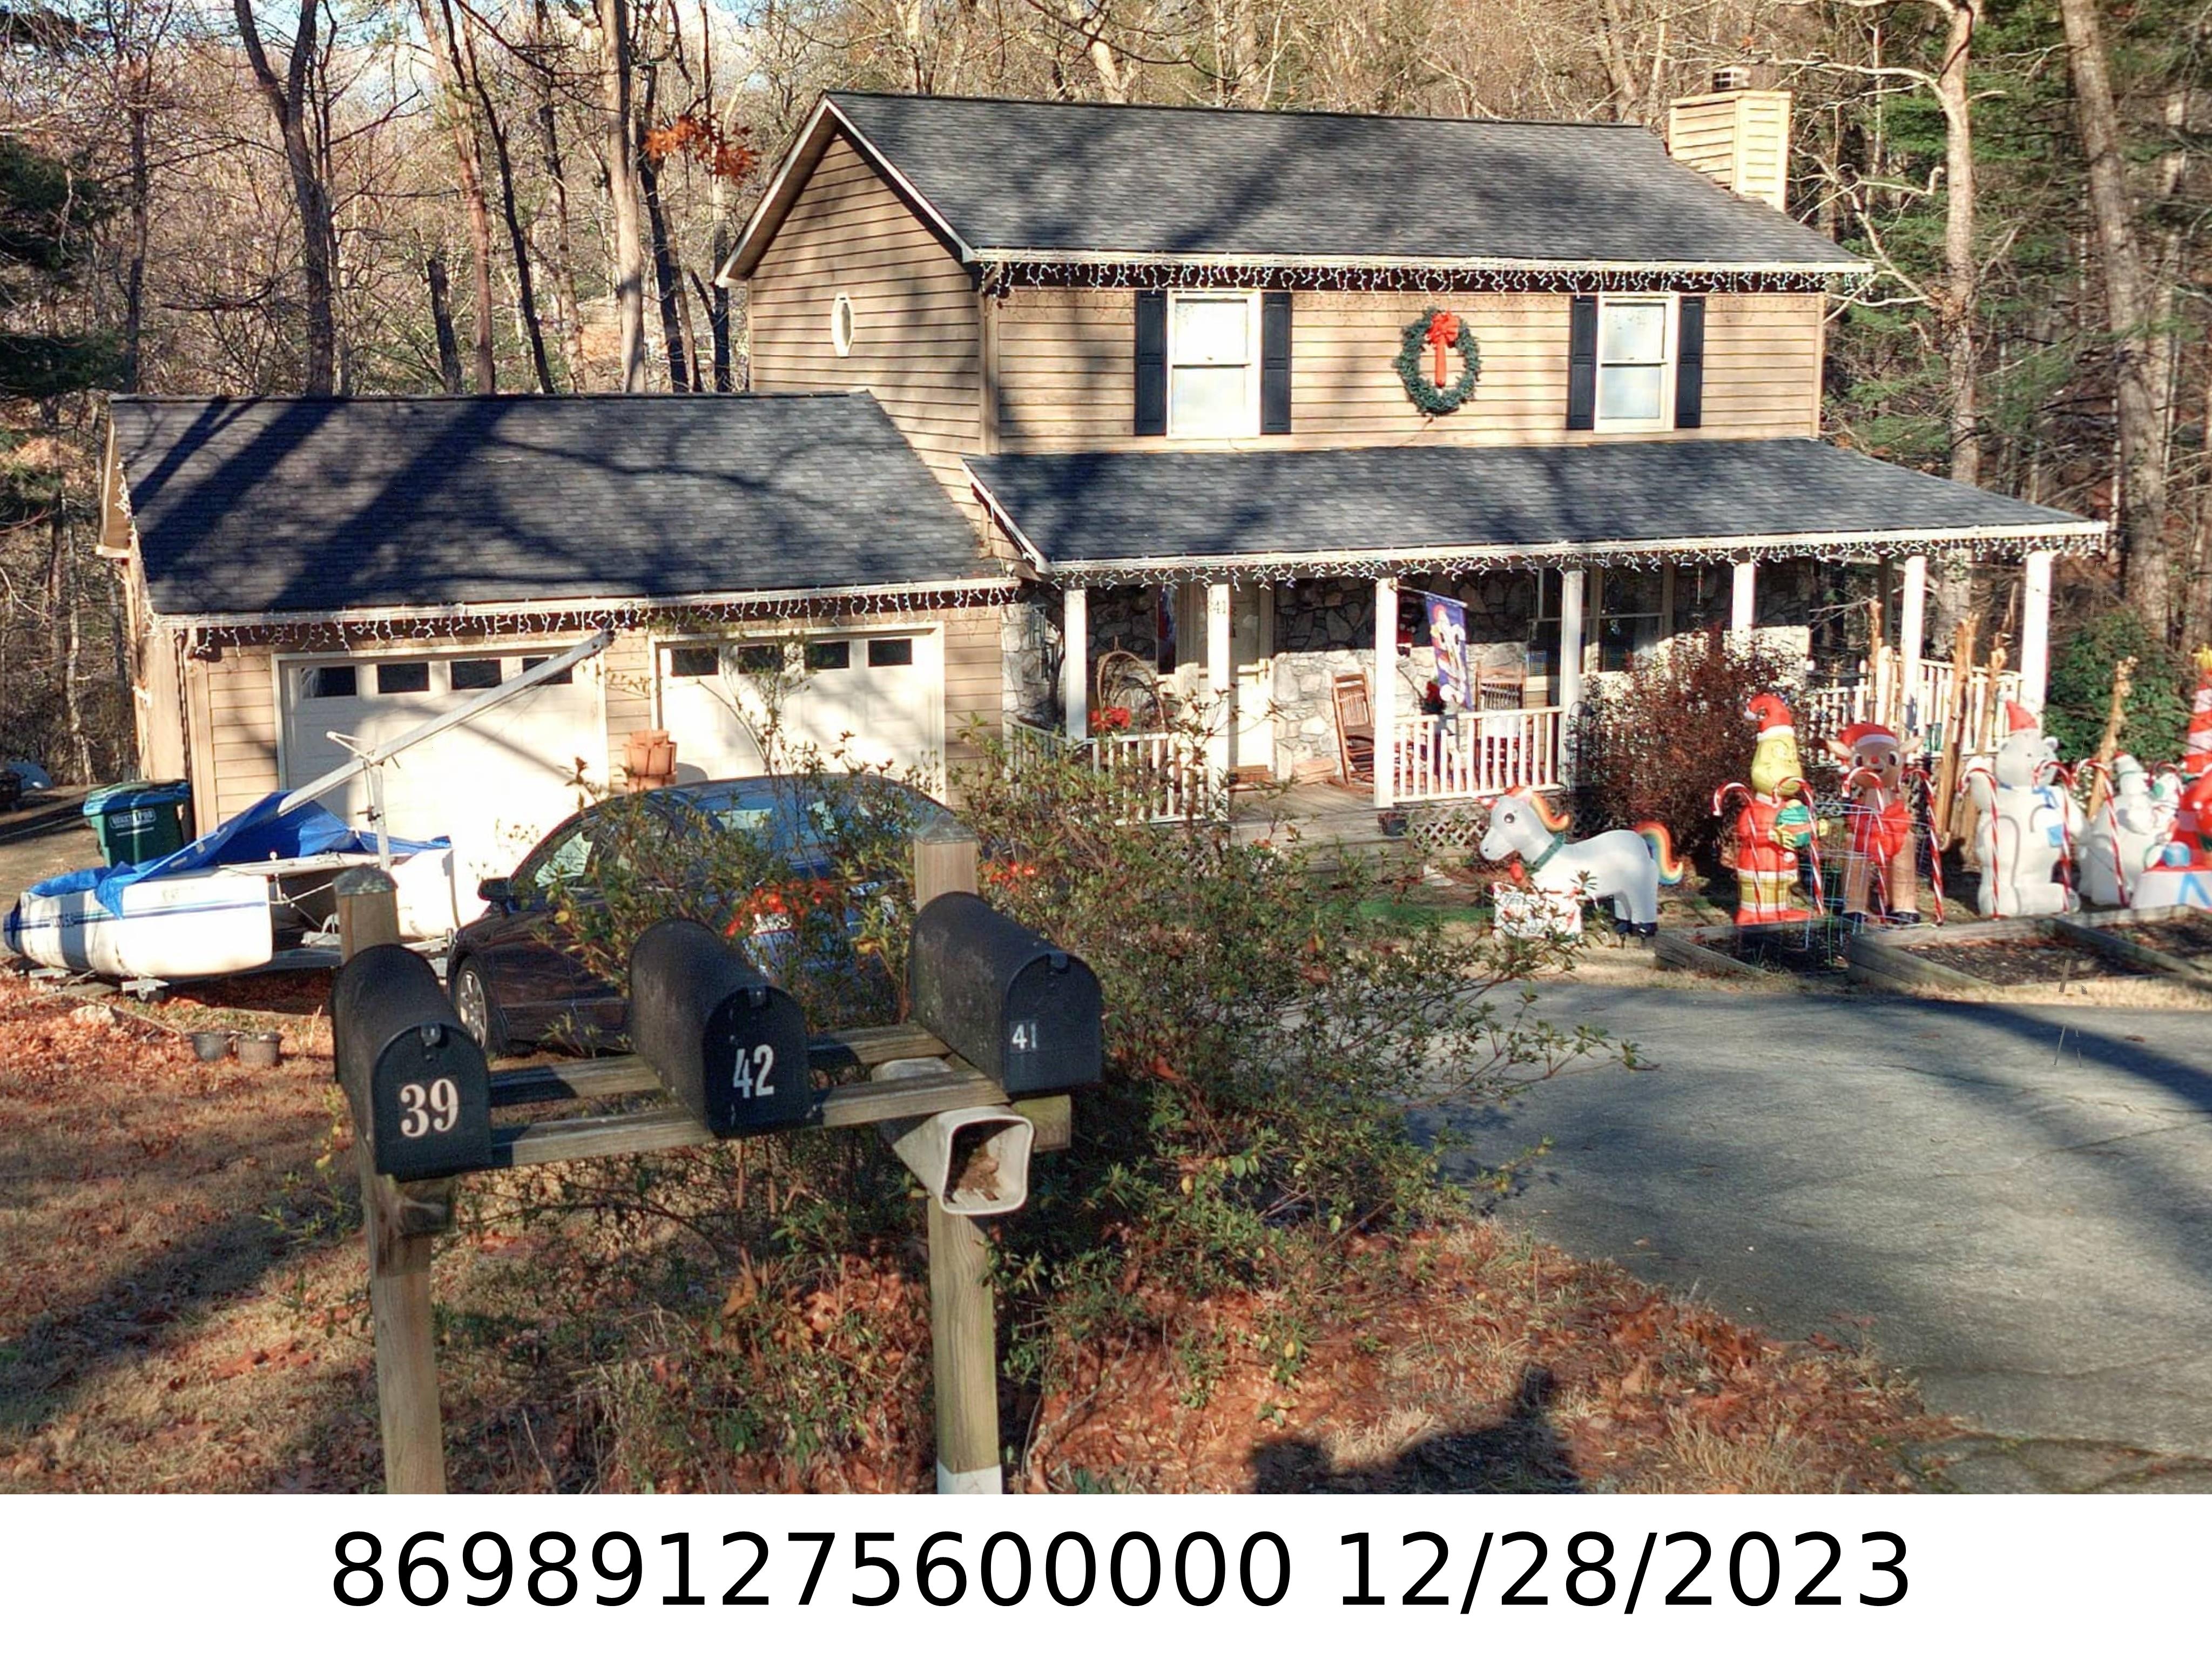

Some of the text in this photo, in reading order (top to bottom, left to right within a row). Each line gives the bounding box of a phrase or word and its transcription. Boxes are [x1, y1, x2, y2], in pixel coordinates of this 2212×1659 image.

[1011, 1024, 1037, 1051] 41
[733, 1044, 774, 1098] 42
[401, 1078, 458, 1137] 39
